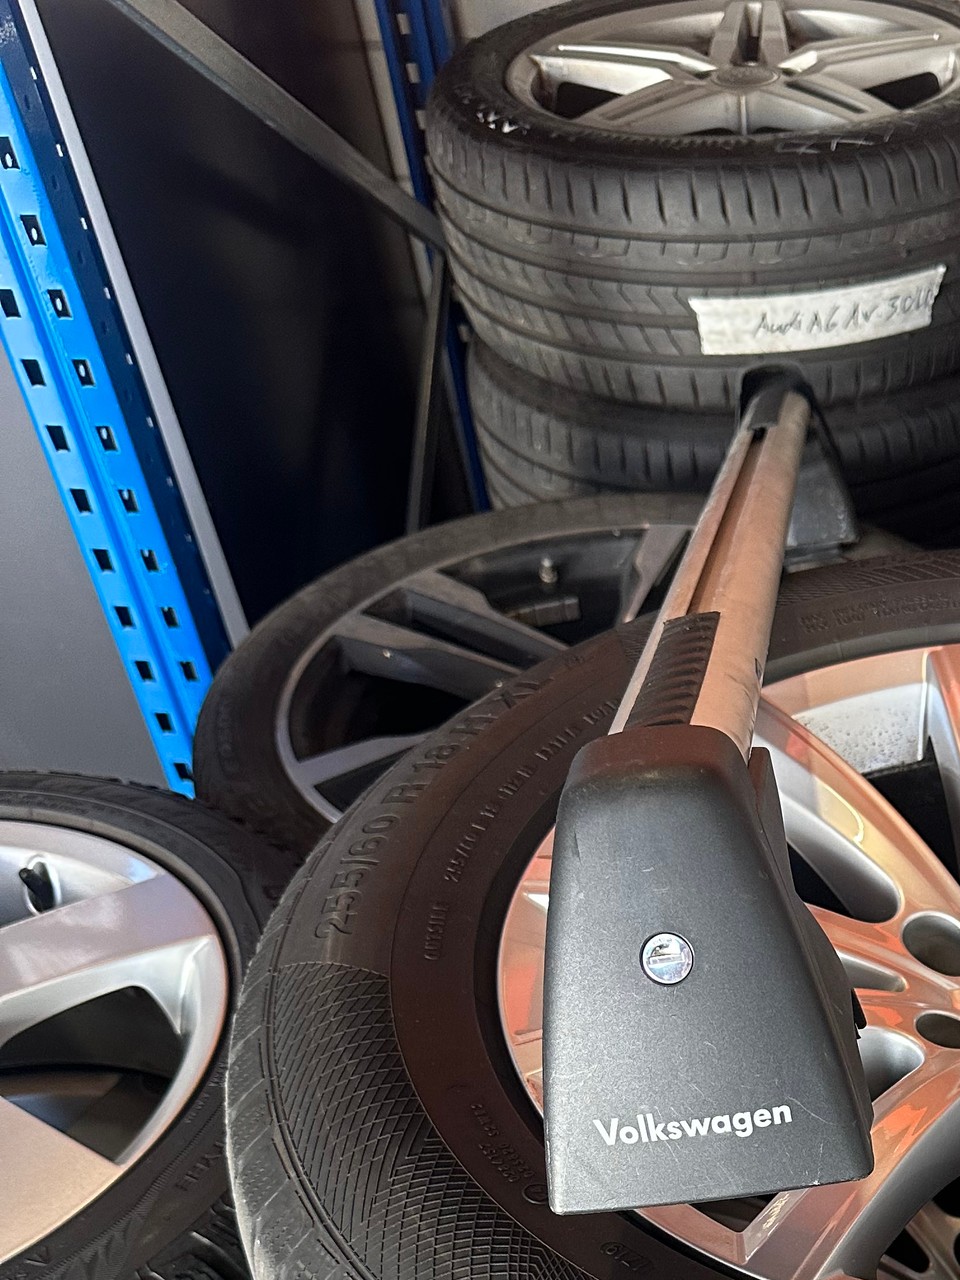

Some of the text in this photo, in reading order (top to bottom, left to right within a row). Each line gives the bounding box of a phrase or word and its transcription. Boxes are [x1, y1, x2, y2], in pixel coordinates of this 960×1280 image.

[314, 813, 400, 939] 255/60
[381, 781, 428, 806] R
[412, 743, 460, 773] 18
[593, 1104, 793, 1146] Volkswagen
